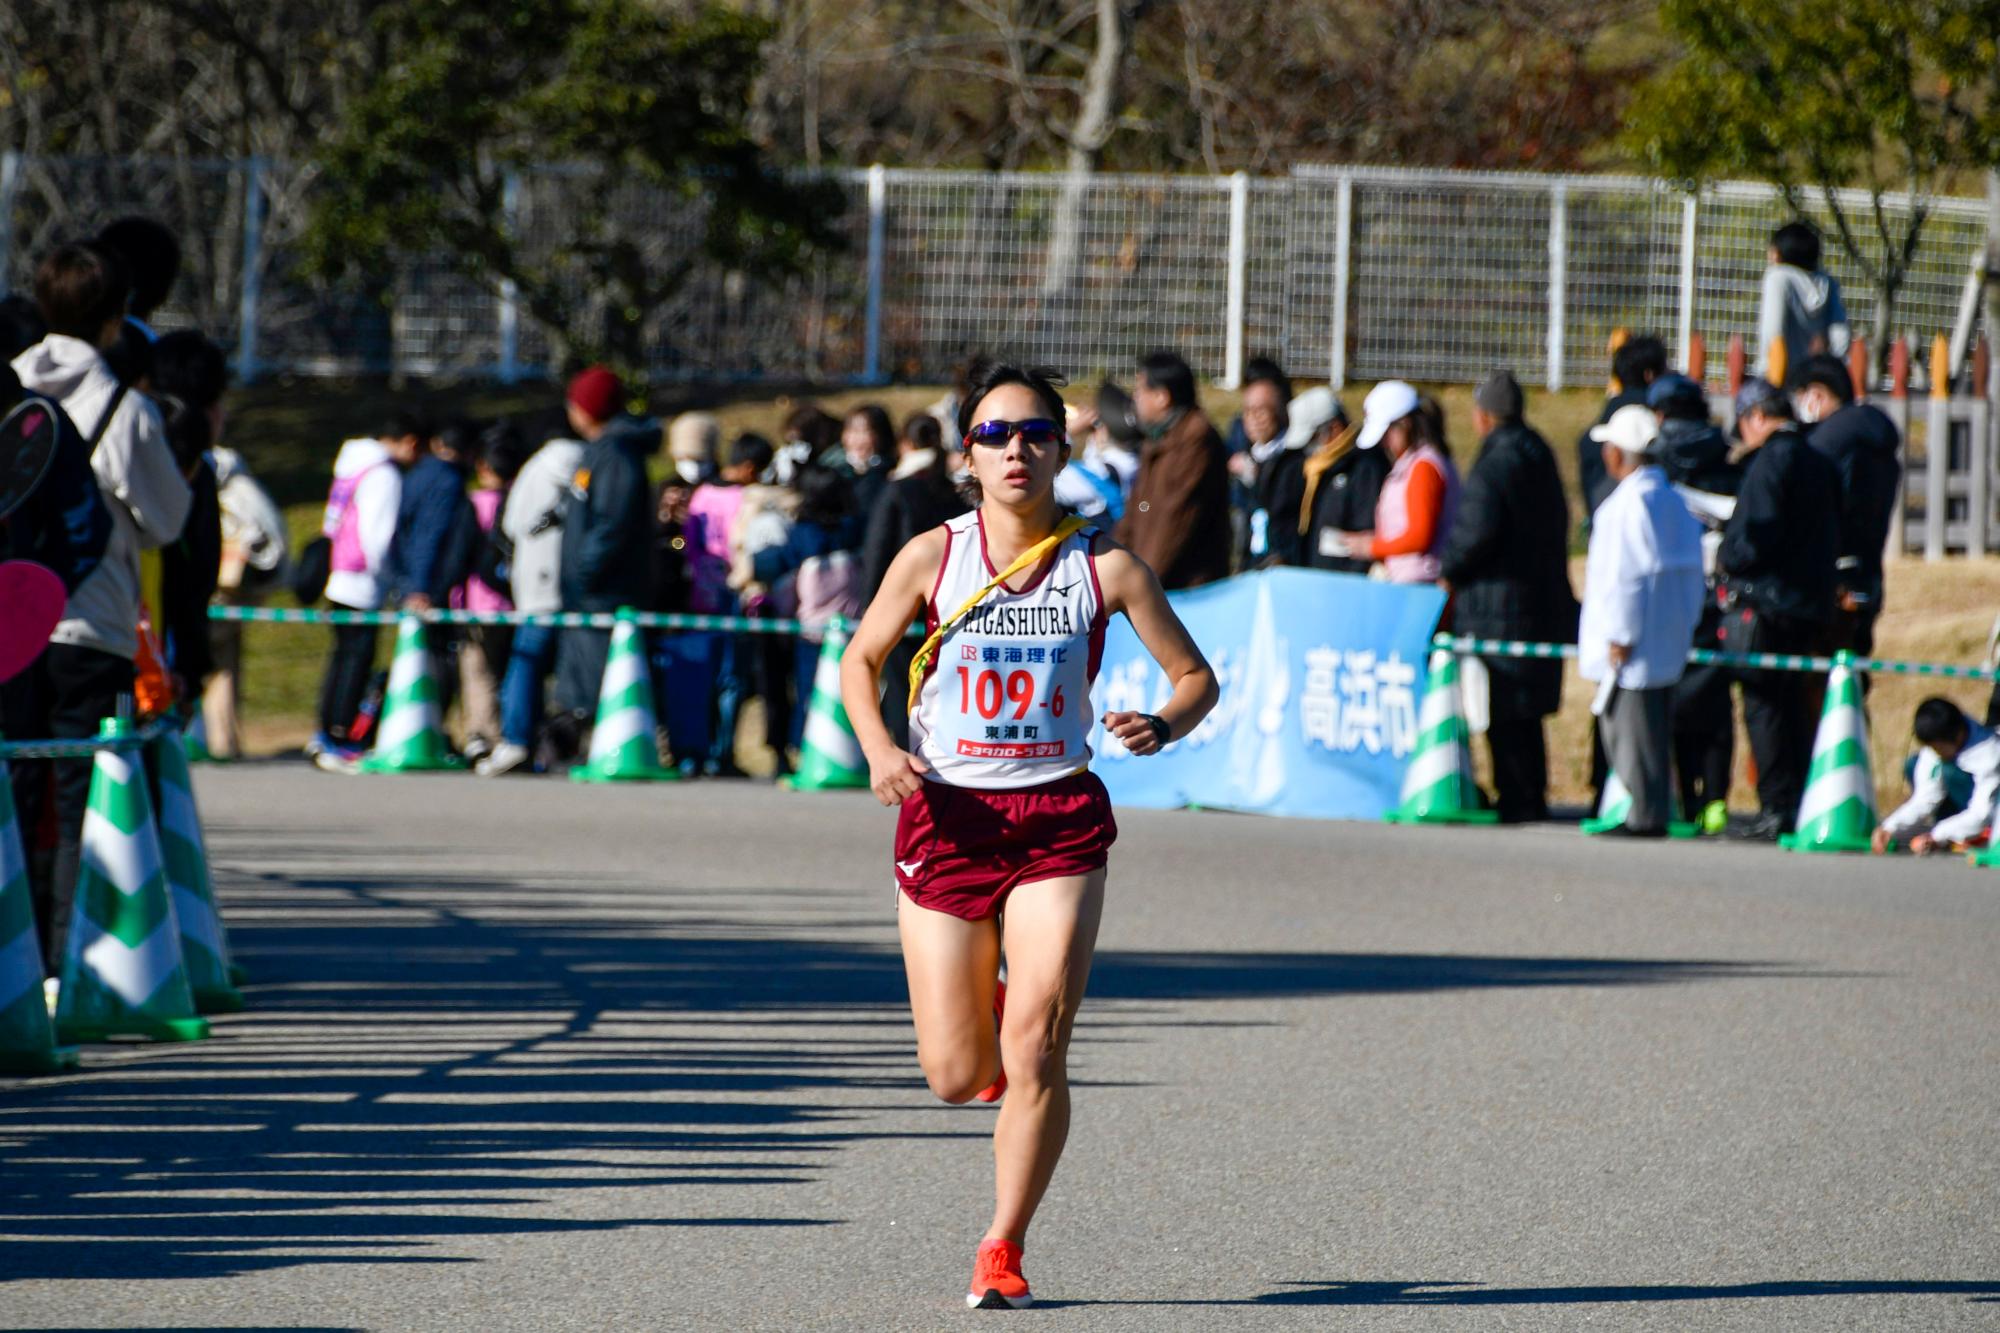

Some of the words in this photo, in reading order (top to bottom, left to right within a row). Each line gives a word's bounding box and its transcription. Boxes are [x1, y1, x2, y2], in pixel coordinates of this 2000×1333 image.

[963, 605, 1072, 636] HIGASHIURA
[982, 646, 1068, 664] 東海理化
[1301, 643, 1416, 759] 高浜市
[985, 725, 1039, 740] 東浦町
